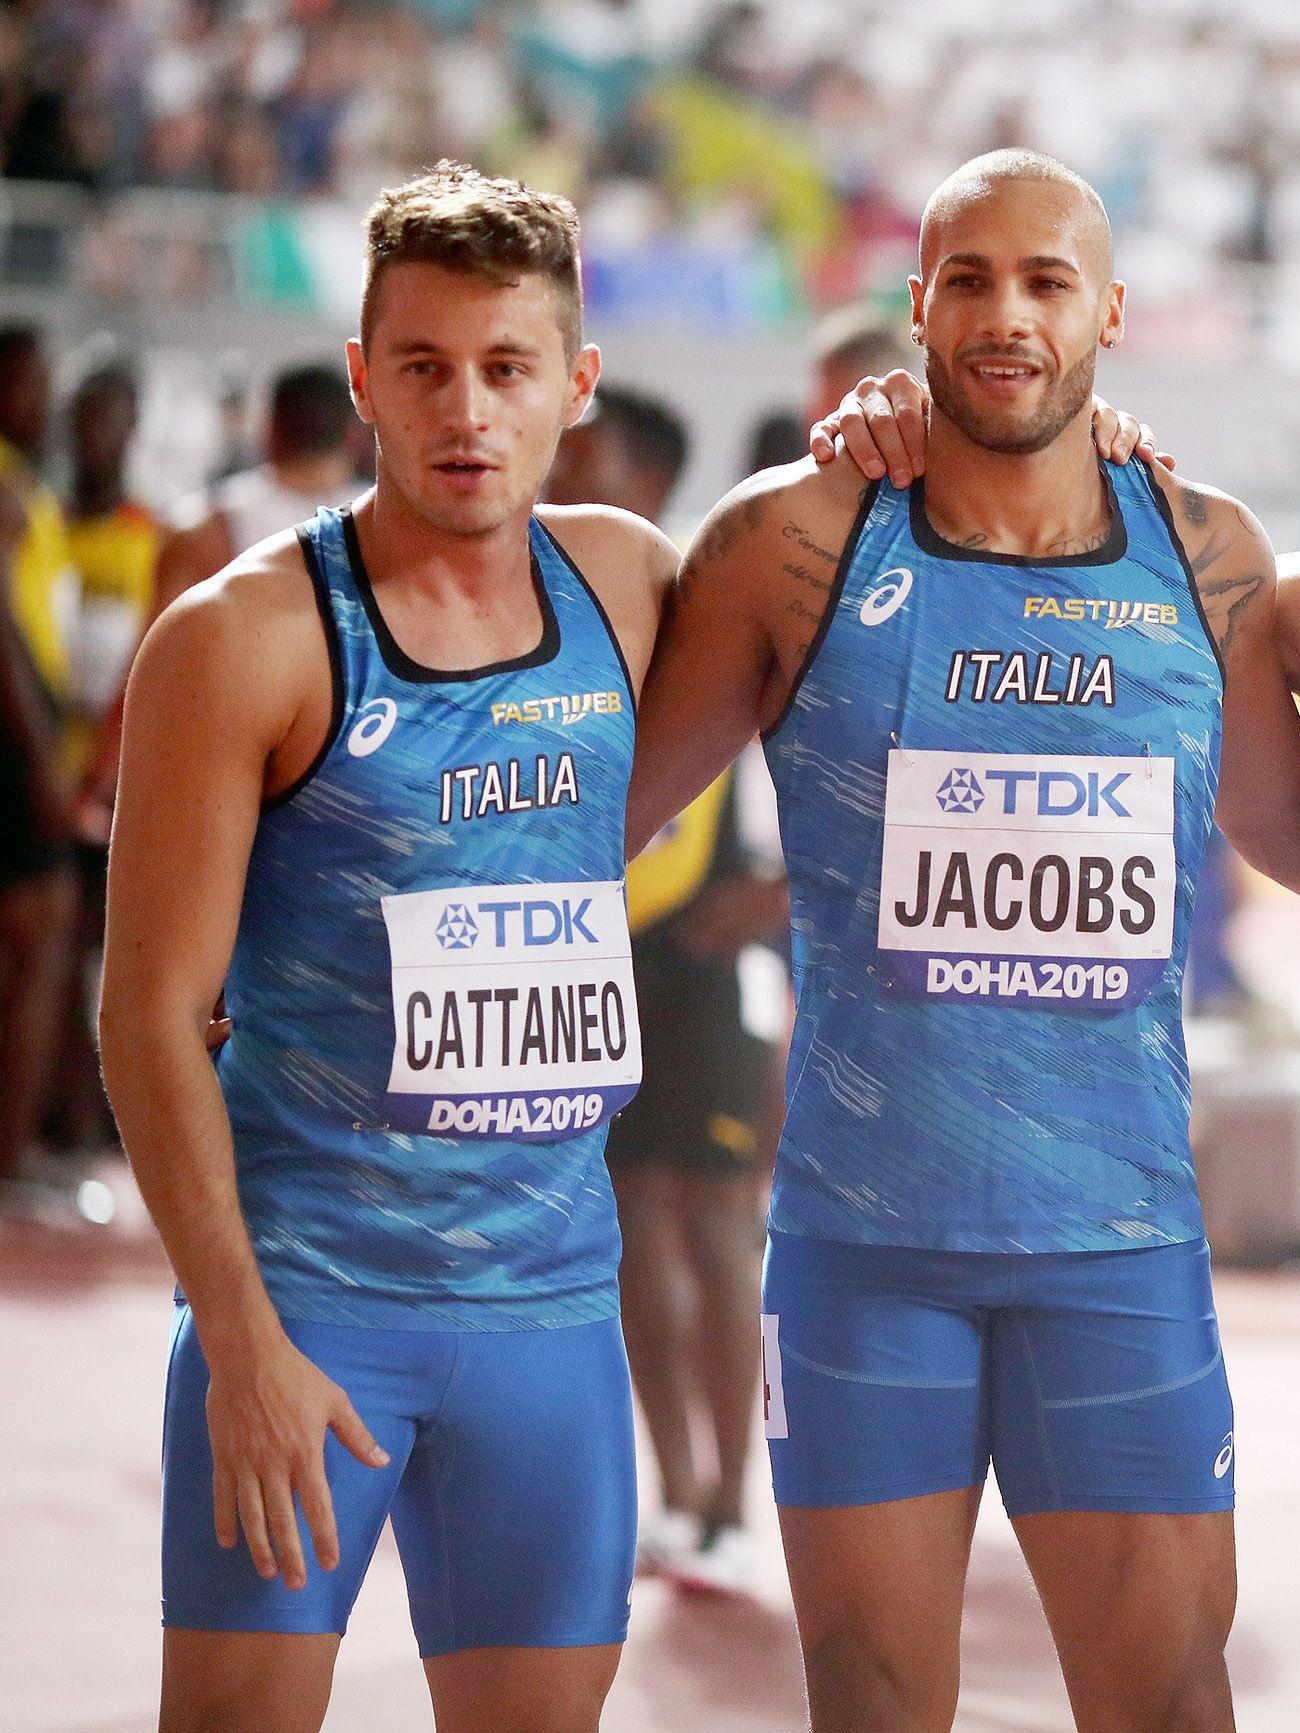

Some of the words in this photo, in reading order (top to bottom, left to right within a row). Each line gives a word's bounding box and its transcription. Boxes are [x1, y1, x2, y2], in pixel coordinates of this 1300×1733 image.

[1023, 597, 1179, 629] FASTWEB
[944, 650, 1116, 706] ITALIA
[491, 691, 622, 726] FASTWEB
[438, 752, 579, 824] ITALIA
[985, 770, 1132, 818] TDK
[894, 851, 1156, 935] JACOBS
[478, 898, 600, 948] TDK
[926, 957, 1129, 1000] DOHA2019
[406, 980, 626, 1071] CATTANEO
[427, 1093, 604, 1134] DOHA2019
